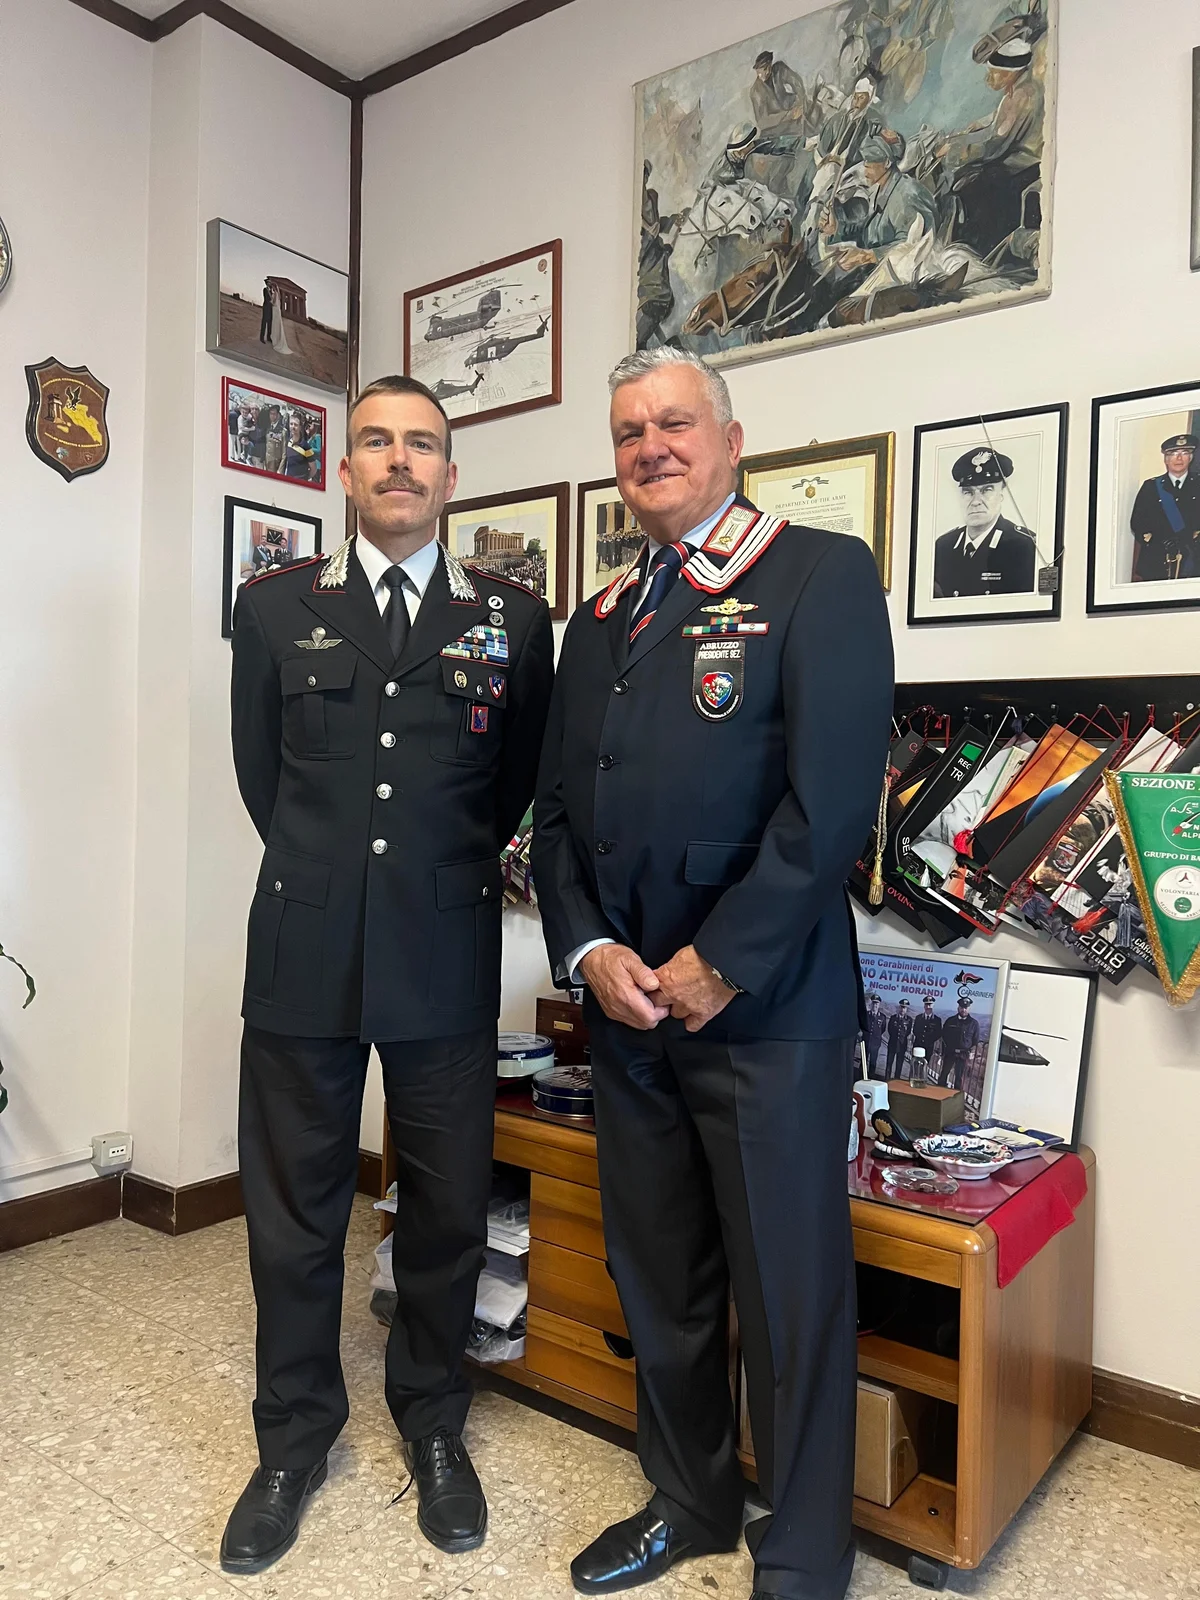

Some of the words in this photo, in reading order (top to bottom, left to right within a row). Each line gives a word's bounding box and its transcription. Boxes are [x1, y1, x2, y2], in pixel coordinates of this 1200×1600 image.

[775, 500, 810, 509] DEPARTMENT
[700, 642, 740, 650] ABRUZZO
[698, 650, 729, 660] PRESIDENTE
[1131, 777, 1196, 791] SEZIONE
[1143, 850, 1178, 860] GRUPPO
[1180, 851, 1189, 860] DI
[1079, 930, 1126, 969] 2018
[860, 958, 875, 966] one
[877, 958, 924, 972] Carabinieri
[926, 964, 934, 972] di
[879, 970, 949, 988] ATTANASIO
[901, 986, 944, 998] MORANDI
[960, 988, 994, 999] CARABINIERI
